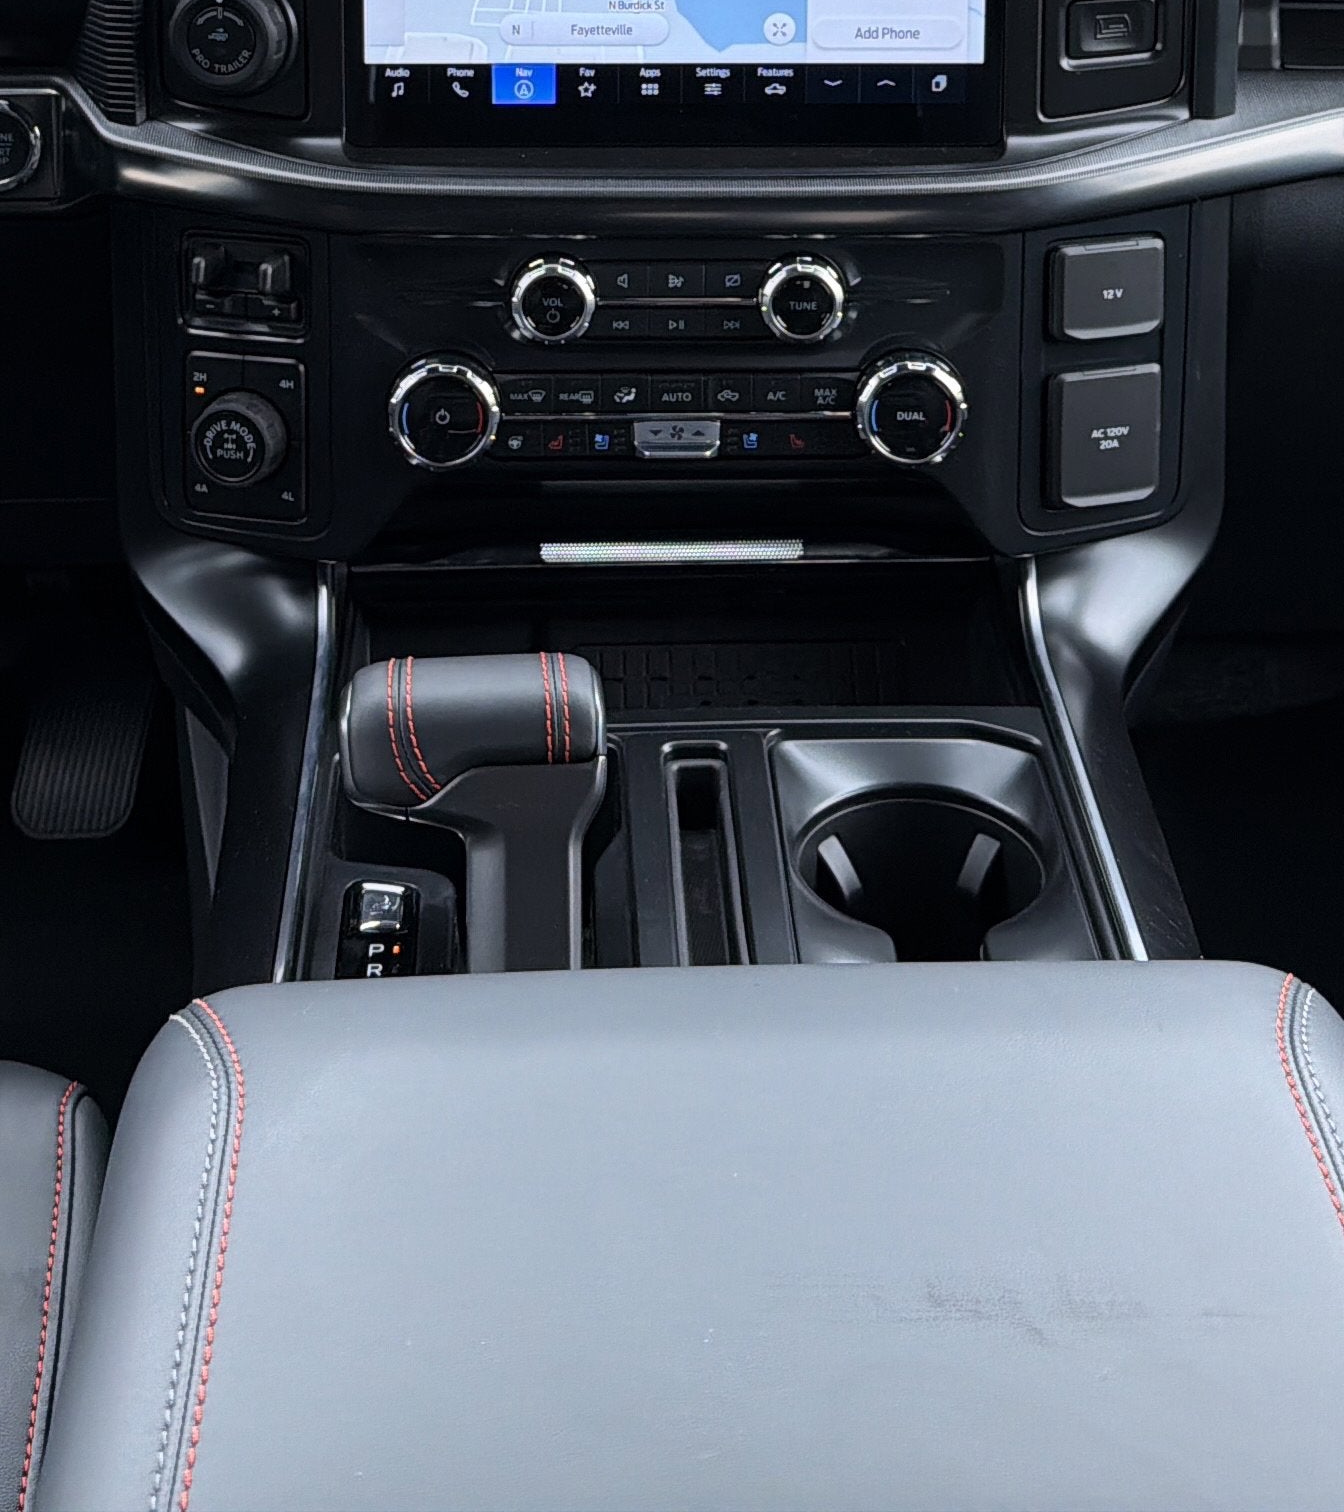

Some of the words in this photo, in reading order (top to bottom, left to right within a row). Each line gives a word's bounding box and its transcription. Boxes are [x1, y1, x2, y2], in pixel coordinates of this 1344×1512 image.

[609, 0, 616, 10] N
[618, 0, 653, 10] Burdick
[654, 0, 665, 10] St
[512, 25, 521, 36] N
[571, 24, 633, 38] Fayetteville
[855, 27, 878, 39] Add
[881, 27, 920, 39] Phone
[192, 48, 210, 69] PRO
[214, 49, 253, 73] TRAILER
[385, 68, 410, 77] Audio
[447, 68, 474, 77] Phone
[515, 68, 533, 77] Nav
[579, 68, 595, 77] Fav
[639, 68, 661, 79] Apps
[696, 67, 730, 78] Settings
[757, 67, 794, 77] Features
[542, 297, 563, 307] VOL
[789, 301, 817, 311] TUNE
[193, 372, 207, 382] 2H
[279, 379, 294, 389] 4H
[559, 393, 579, 401] REAR
[662, 393, 691, 402] AUTO
[767, 392, 786, 401] A/C
[814, 389, 837, 397] MAX
[816, 396, 835, 405] A/C
[896, 411, 925, 421] DUAL
[204, 420, 228, 447] DRIVE
[230, 421, 256, 449] MODE
[1091, 428, 1105, 439] AC
[1106, 426, 1129, 438] 120V
[1099, 439, 1120, 450] 20A
[217, 450, 244, 460] PUSH
[194, 483, 208, 493] 4A
[281, 491, 295, 501] 4L
[368, 943, 385, 958] P
[367, 963, 383, 978] R
